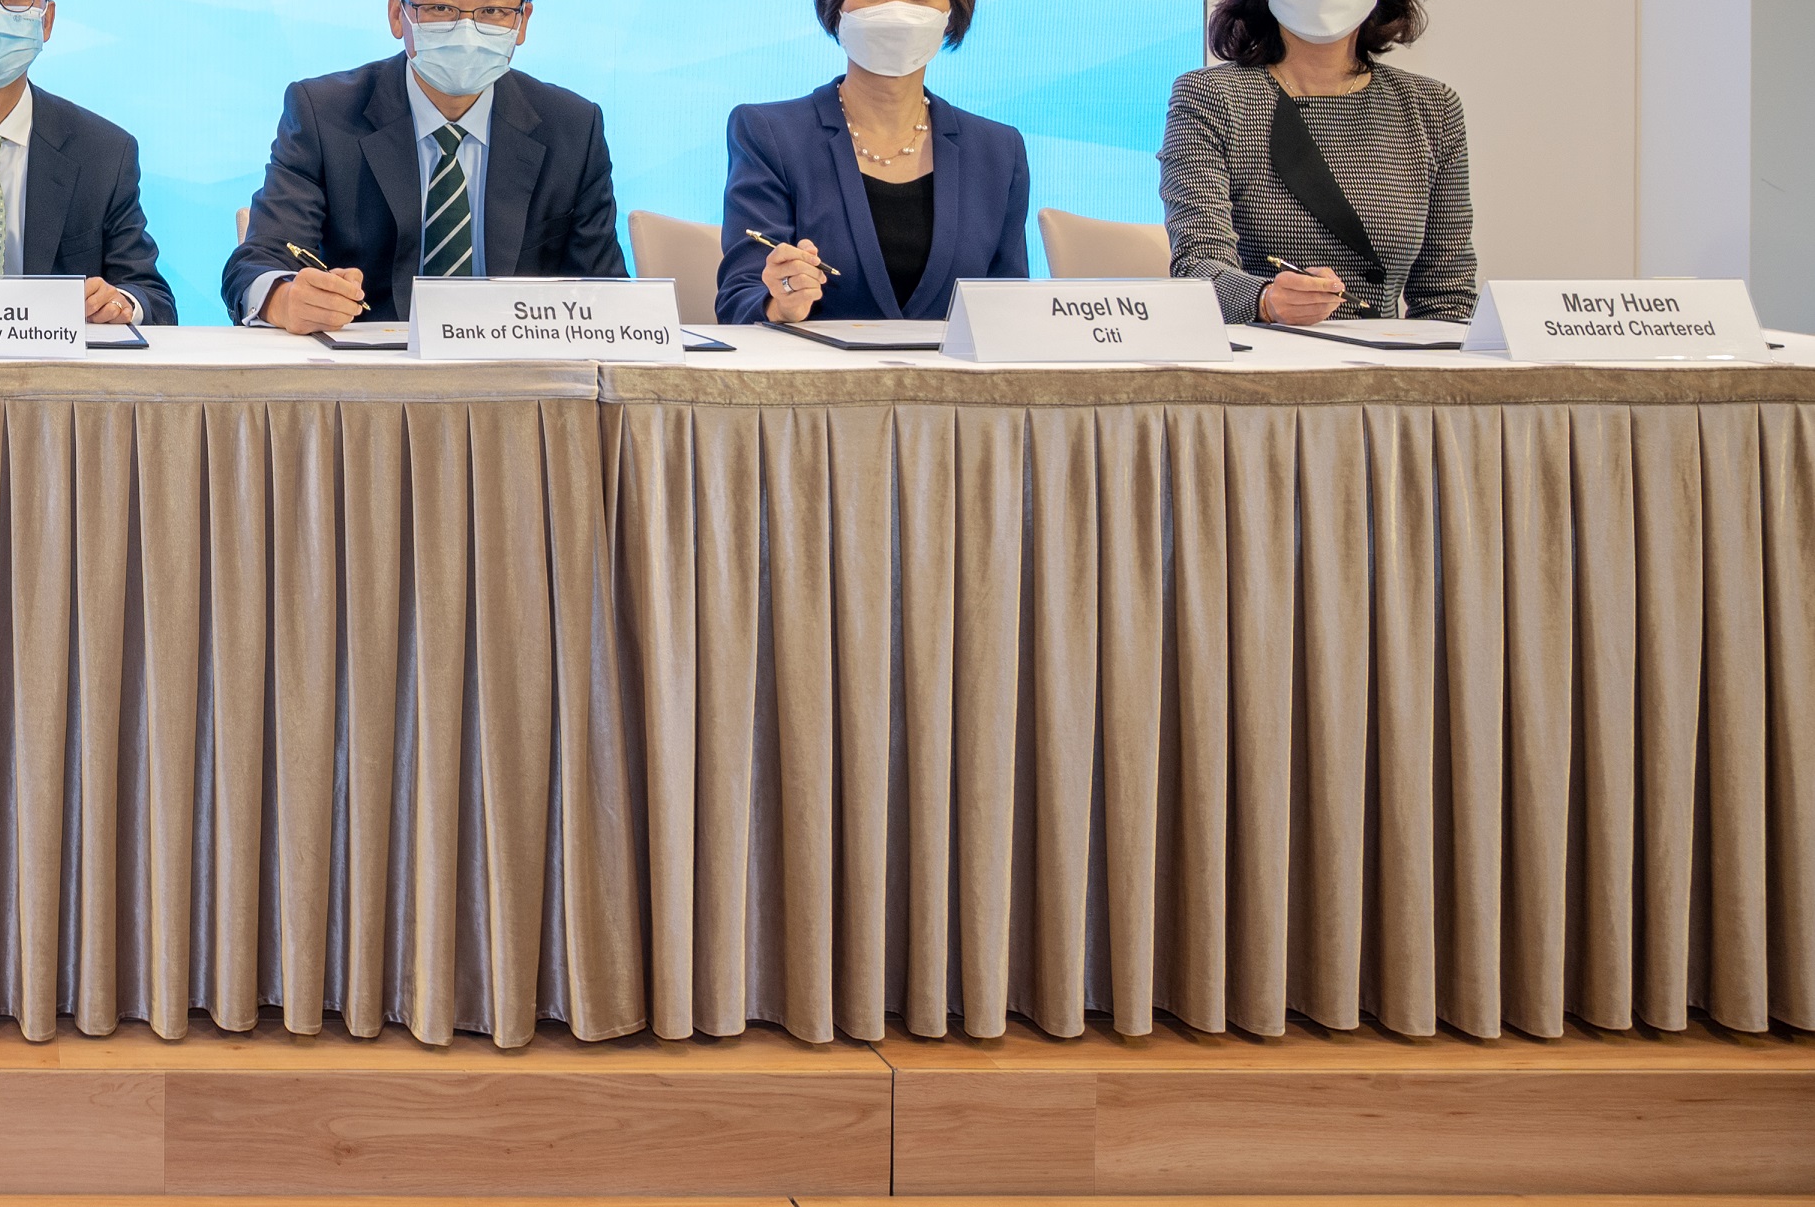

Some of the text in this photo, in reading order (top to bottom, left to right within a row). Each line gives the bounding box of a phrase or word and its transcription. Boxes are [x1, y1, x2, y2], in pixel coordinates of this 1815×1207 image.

[514, 302, 592, 320] Sun Yu
[1052, 297, 1148, 320] Angel Ng
[1562, 294, 1679, 317] Mary Huen
[8, 327, 77, 343] Authority
[442, 324, 669, 344] Bank of China (Hong Kong)
[1093, 328, 1123, 343] Citi
[1545, 321, 1715, 336] Standard Chartered
